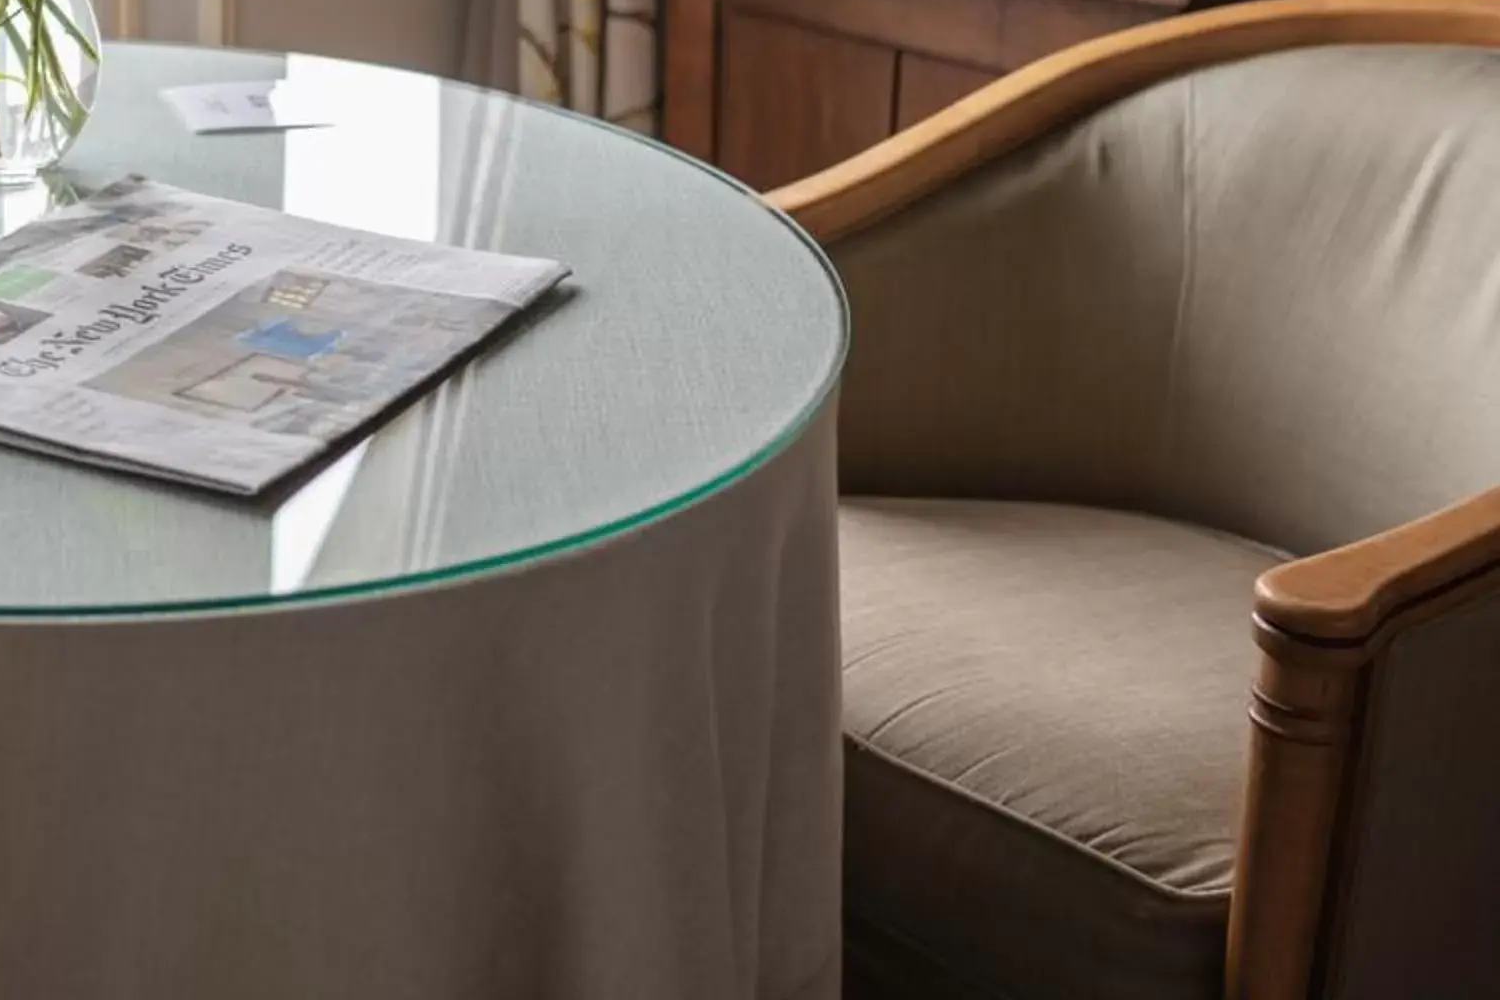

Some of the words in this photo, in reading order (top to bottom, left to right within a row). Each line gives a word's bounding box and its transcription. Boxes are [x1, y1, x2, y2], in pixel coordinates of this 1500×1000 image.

[41, 319, 121, 355] New
[98, 283, 188, 325] York
[158, 243, 253, 285] Times
